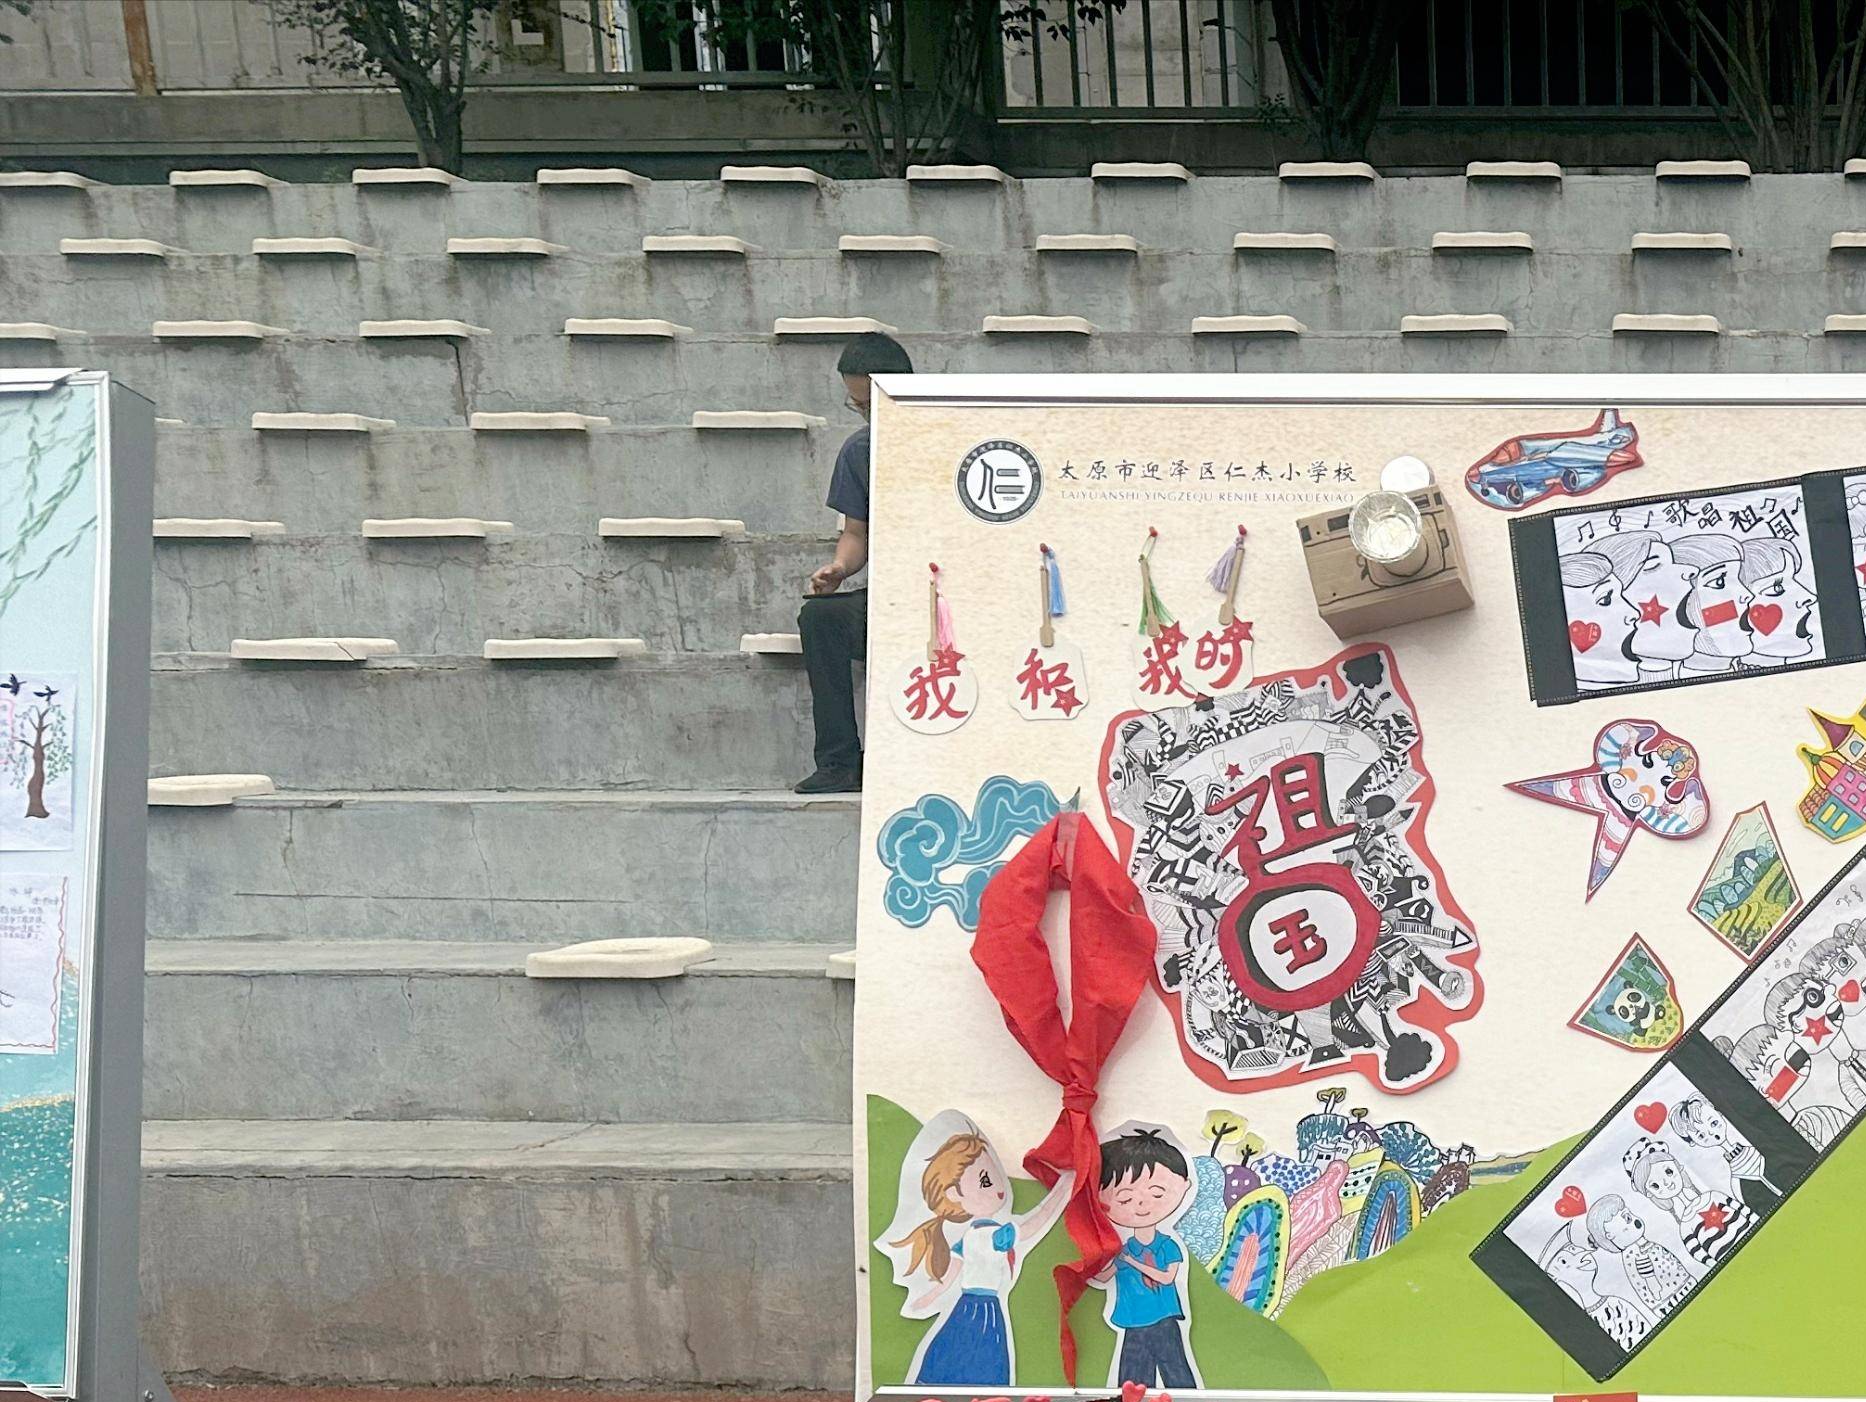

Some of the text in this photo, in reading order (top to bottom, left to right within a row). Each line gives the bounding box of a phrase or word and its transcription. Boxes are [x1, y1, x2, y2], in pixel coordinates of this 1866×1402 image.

[1058, 459, 1357, 483] 太原市迎泽区仁杰小学校
[1219, 491, 1259, 502] RENJIE
[1662, 499, 1800, 541] 歌唱祖国
